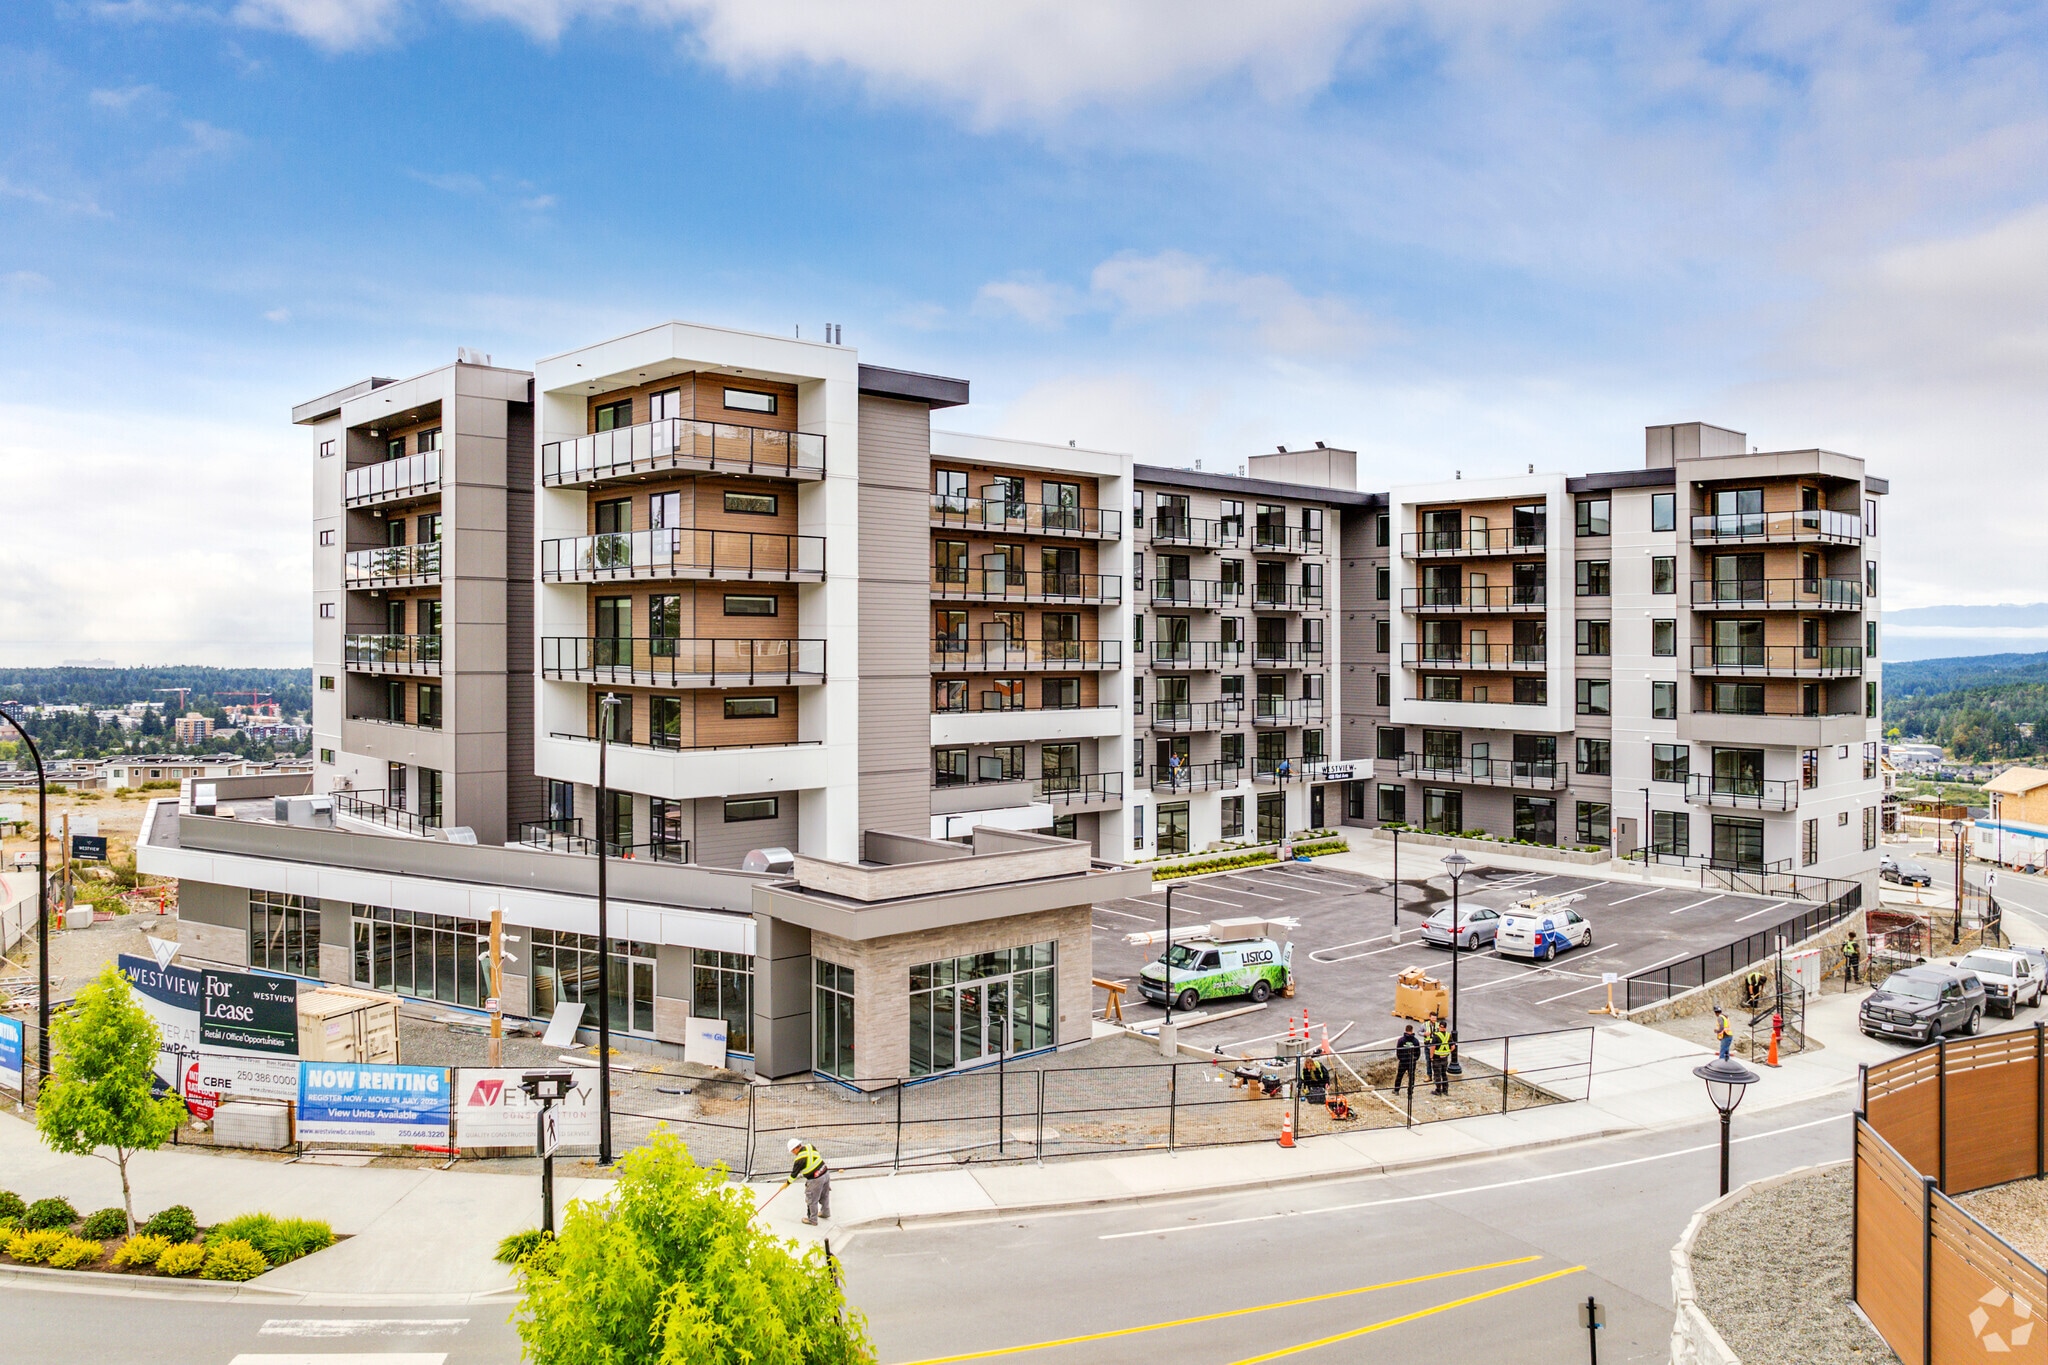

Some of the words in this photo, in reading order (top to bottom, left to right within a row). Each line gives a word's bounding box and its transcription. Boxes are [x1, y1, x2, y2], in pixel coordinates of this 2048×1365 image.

[1322, 764, 1354, 773] WESTVIEW
[1241, 950, 1273, 963] LISTCO
[129, 966, 199, 996] WESTVIEW
[205, 975, 233, 998] For
[253, 991, 295, 1003] WESTVIEW
[205, 997, 254, 1022] Lease
[204, 1029, 221, 1040] Retail
[226, 1032, 244, 1042] Office
[244, 1034, 285, 1047] Opportunities
[203, 1076, 232, 1089] CBRE
[237, 1070, 254, 1082] 250
[254, 1072, 271, 1084] 386
[272, 1074, 297, 1087] 0000
[309, 1070, 355, 1088] NOW
[359, 1073, 439, 1092] RENTING
[308, 1094, 343, 1103] REGISTER
[343, 1095, 363, 1103] NOW
[368, 1096, 389, 1104] MOVE
[391, 1097, 400, 1105] IN
[420, 1097, 439, 1106] 2025
[327, 1108, 350, 1119] View
[352, 1109, 376, 1119] Units
[376, 1110, 418, 1121] Available
[503, 1111, 587, 1120] CONSTTION
[299, 1128, 376, 1137] www.westviewbc.ca/rentals
[398, 1129, 445, 1139] 250.668.3220
